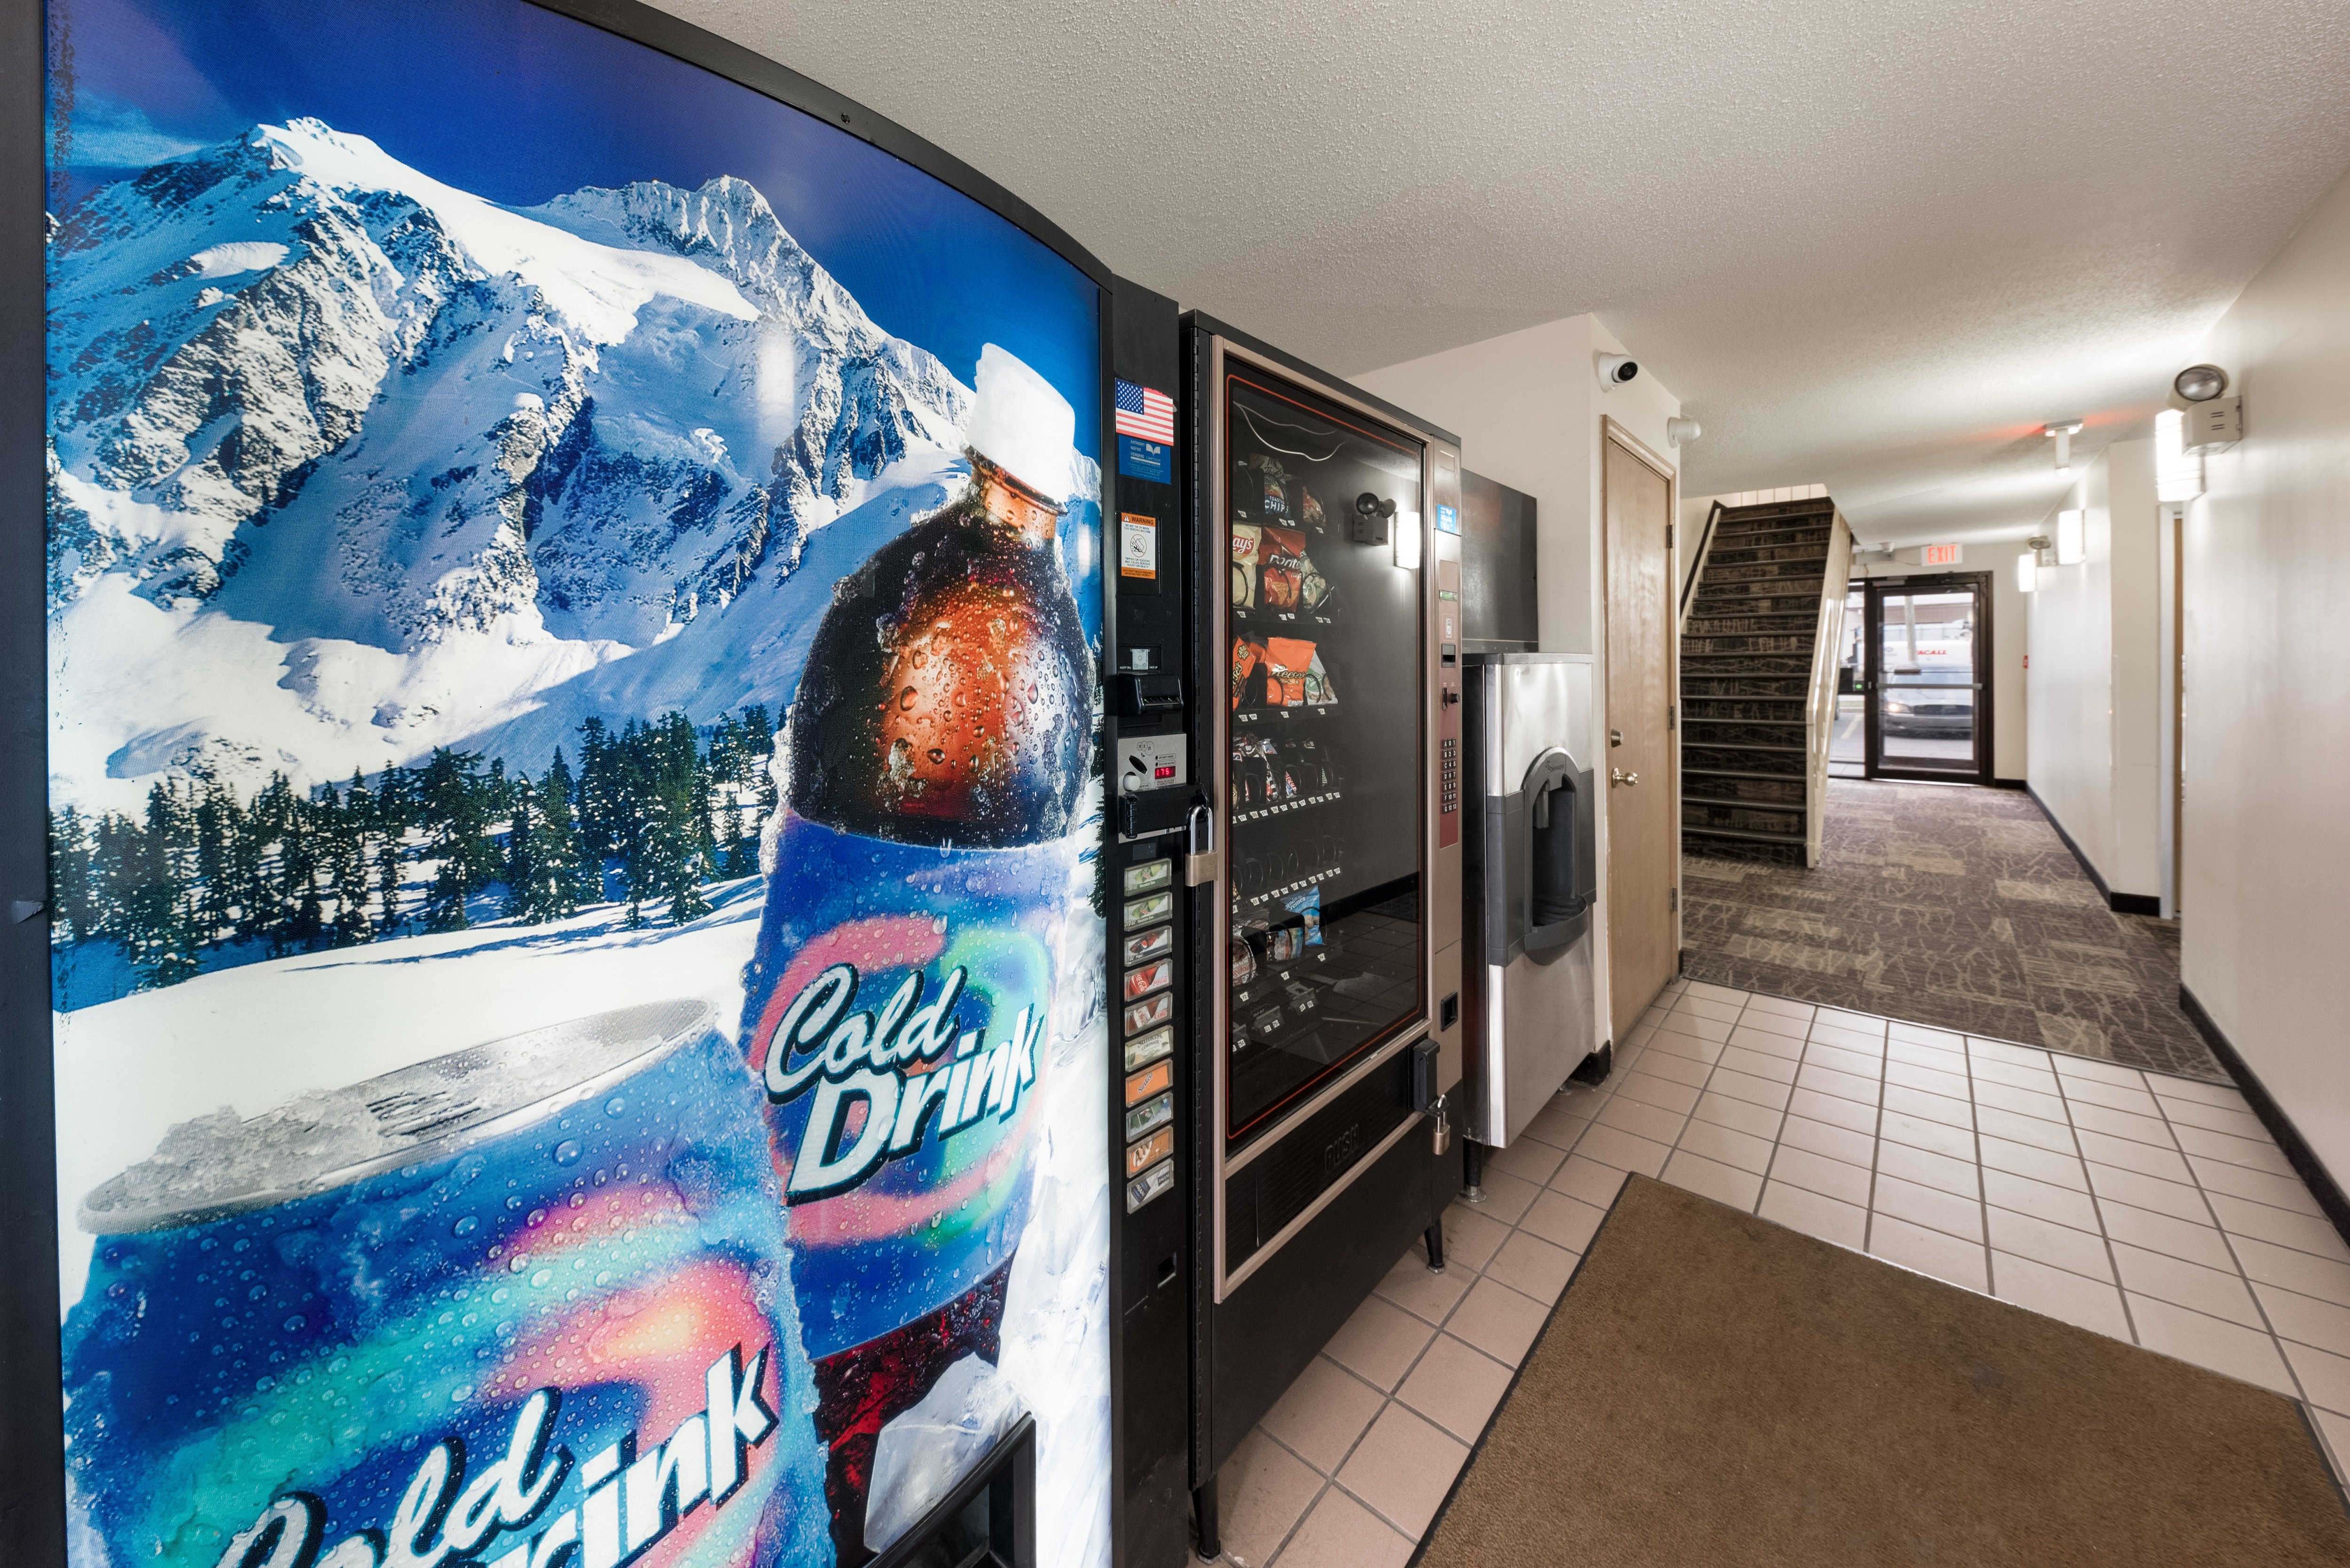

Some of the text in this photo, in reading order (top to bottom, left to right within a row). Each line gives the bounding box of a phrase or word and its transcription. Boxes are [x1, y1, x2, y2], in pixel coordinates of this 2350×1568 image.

[1265, 499, 1289, 514] CHIPS
[1269, 496, 1285, 505] TOASTED
[1132, 516, 1153, 525] WARNING
[1233, 538, 1253, 554] ay's
[1269, 554, 1302, 569] Dorito
[1928, 545, 1957, 564] EXIT
[1271, 665, 1307, 679] Reese's
[1289, 897, 1306, 911] remes
[1153, 975, 1168, 987] Coca-Cola
[1154, 1009, 1168, 1020] Coke
[763, 963, 967, 1104] Cold
[1142, 1039, 1159, 1051] LEMONADE
[785, 1003, 1044, 1206] Drink
[1136, 1183, 1145, 1197] ASANI
